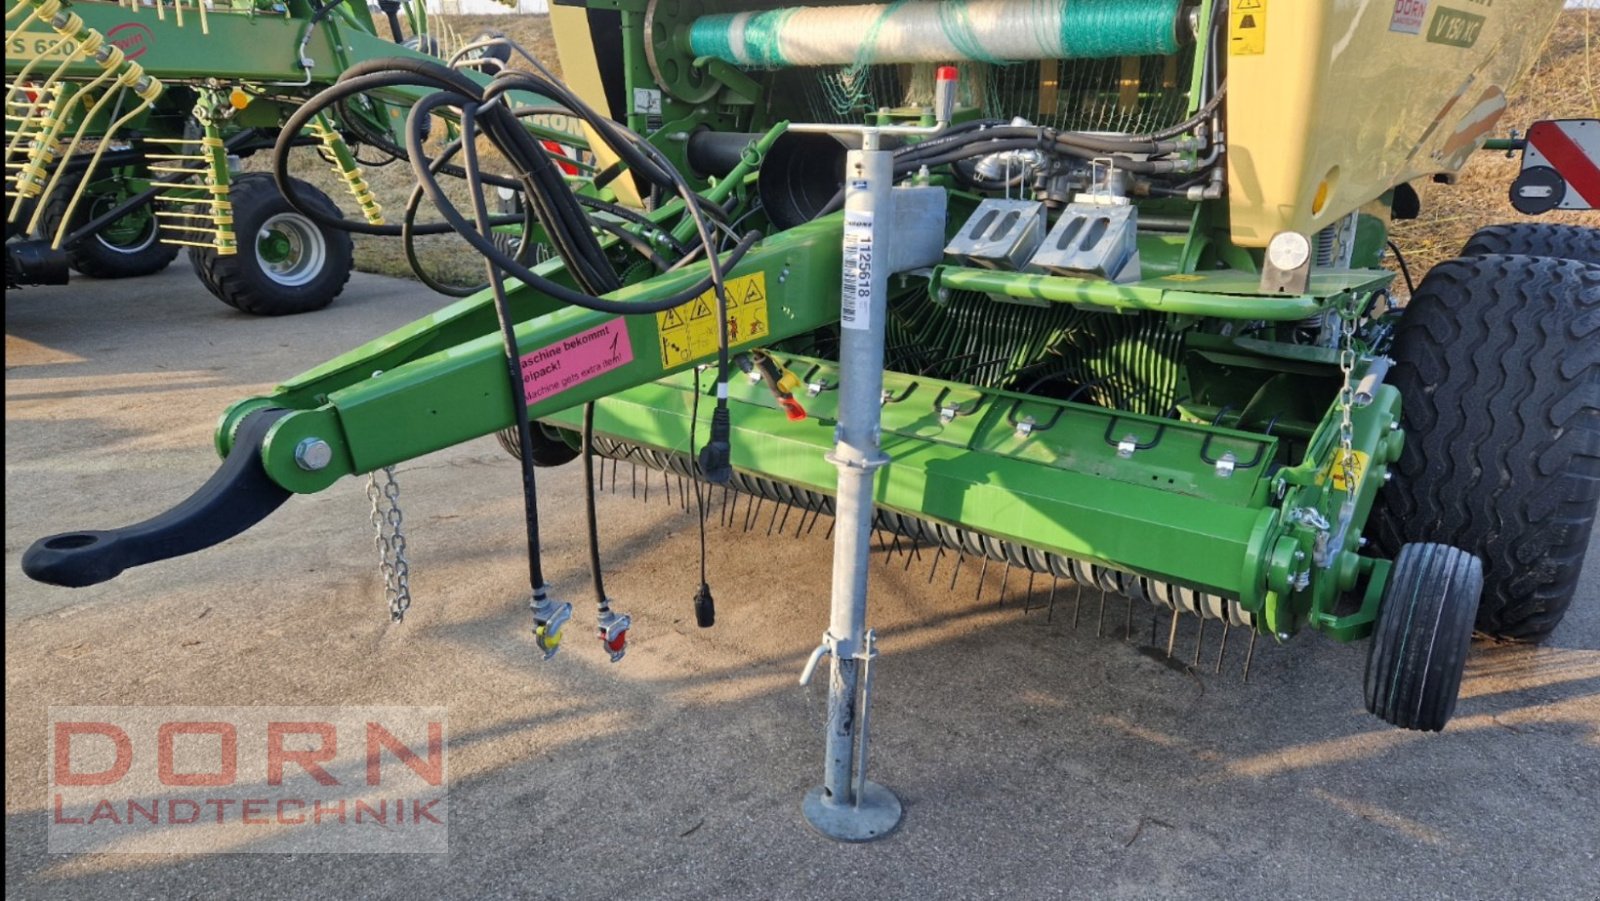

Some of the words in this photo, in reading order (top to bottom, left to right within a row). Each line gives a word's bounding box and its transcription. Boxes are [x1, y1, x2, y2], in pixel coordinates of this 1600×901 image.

[1435, 14, 1449, 37] V
[859, 236, 872, 297] 1125618
[521, 347, 561, 369] aschine
[563, 326, 609, 351] bekommt
[524, 360, 560, 383] eipack!
[561, 373, 580, 387] gets
[581, 363, 601, 376] extra
